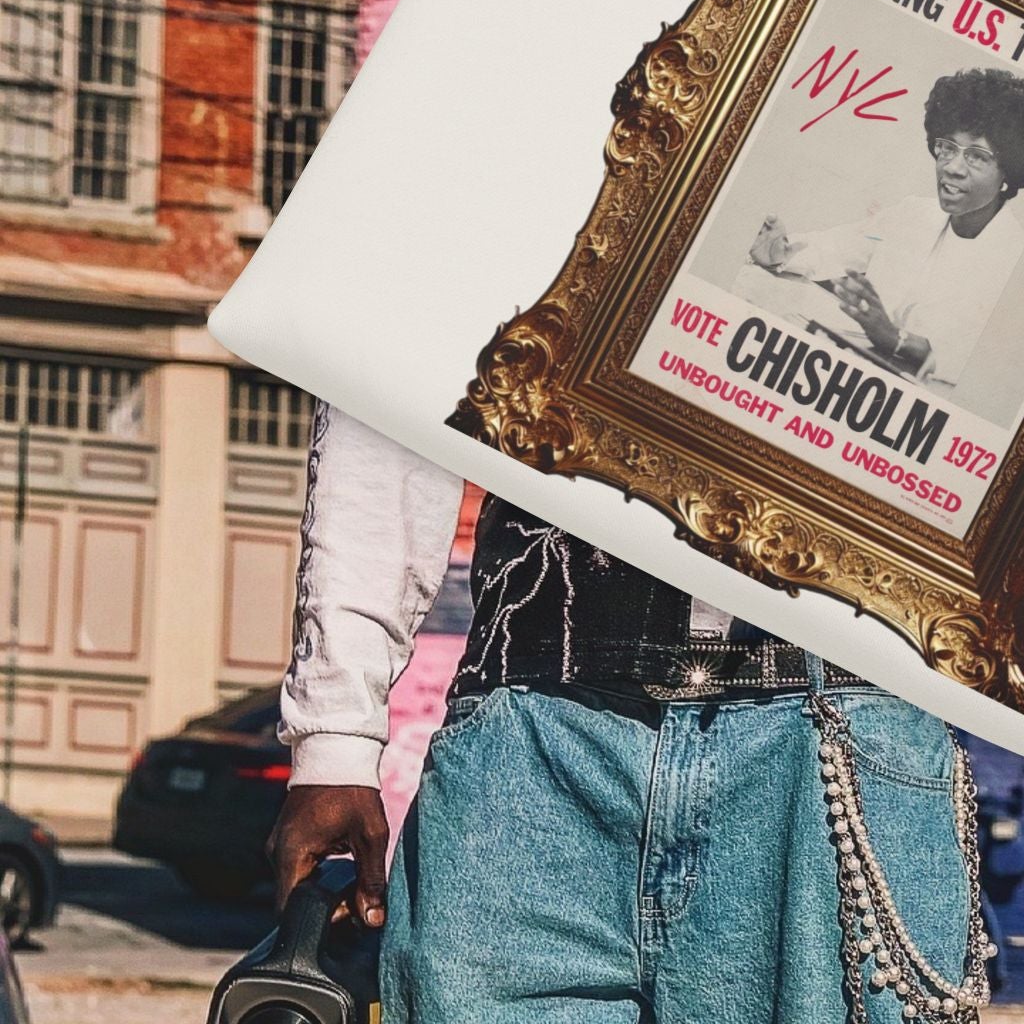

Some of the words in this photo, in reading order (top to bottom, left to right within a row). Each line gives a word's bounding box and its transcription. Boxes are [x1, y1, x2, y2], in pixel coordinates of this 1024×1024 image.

[791, 46, 909, 132] NYC
[659, 351, 784, 424] UNBOUGHT
[785, 416, 835, 450] AND
[841, 442, 963, 514] UNBOSSED
[670, 298, 727, 347] VOTE
[726, 316, 949, 465] CHISHOLM
[942, 436, 998, 481] 1972
